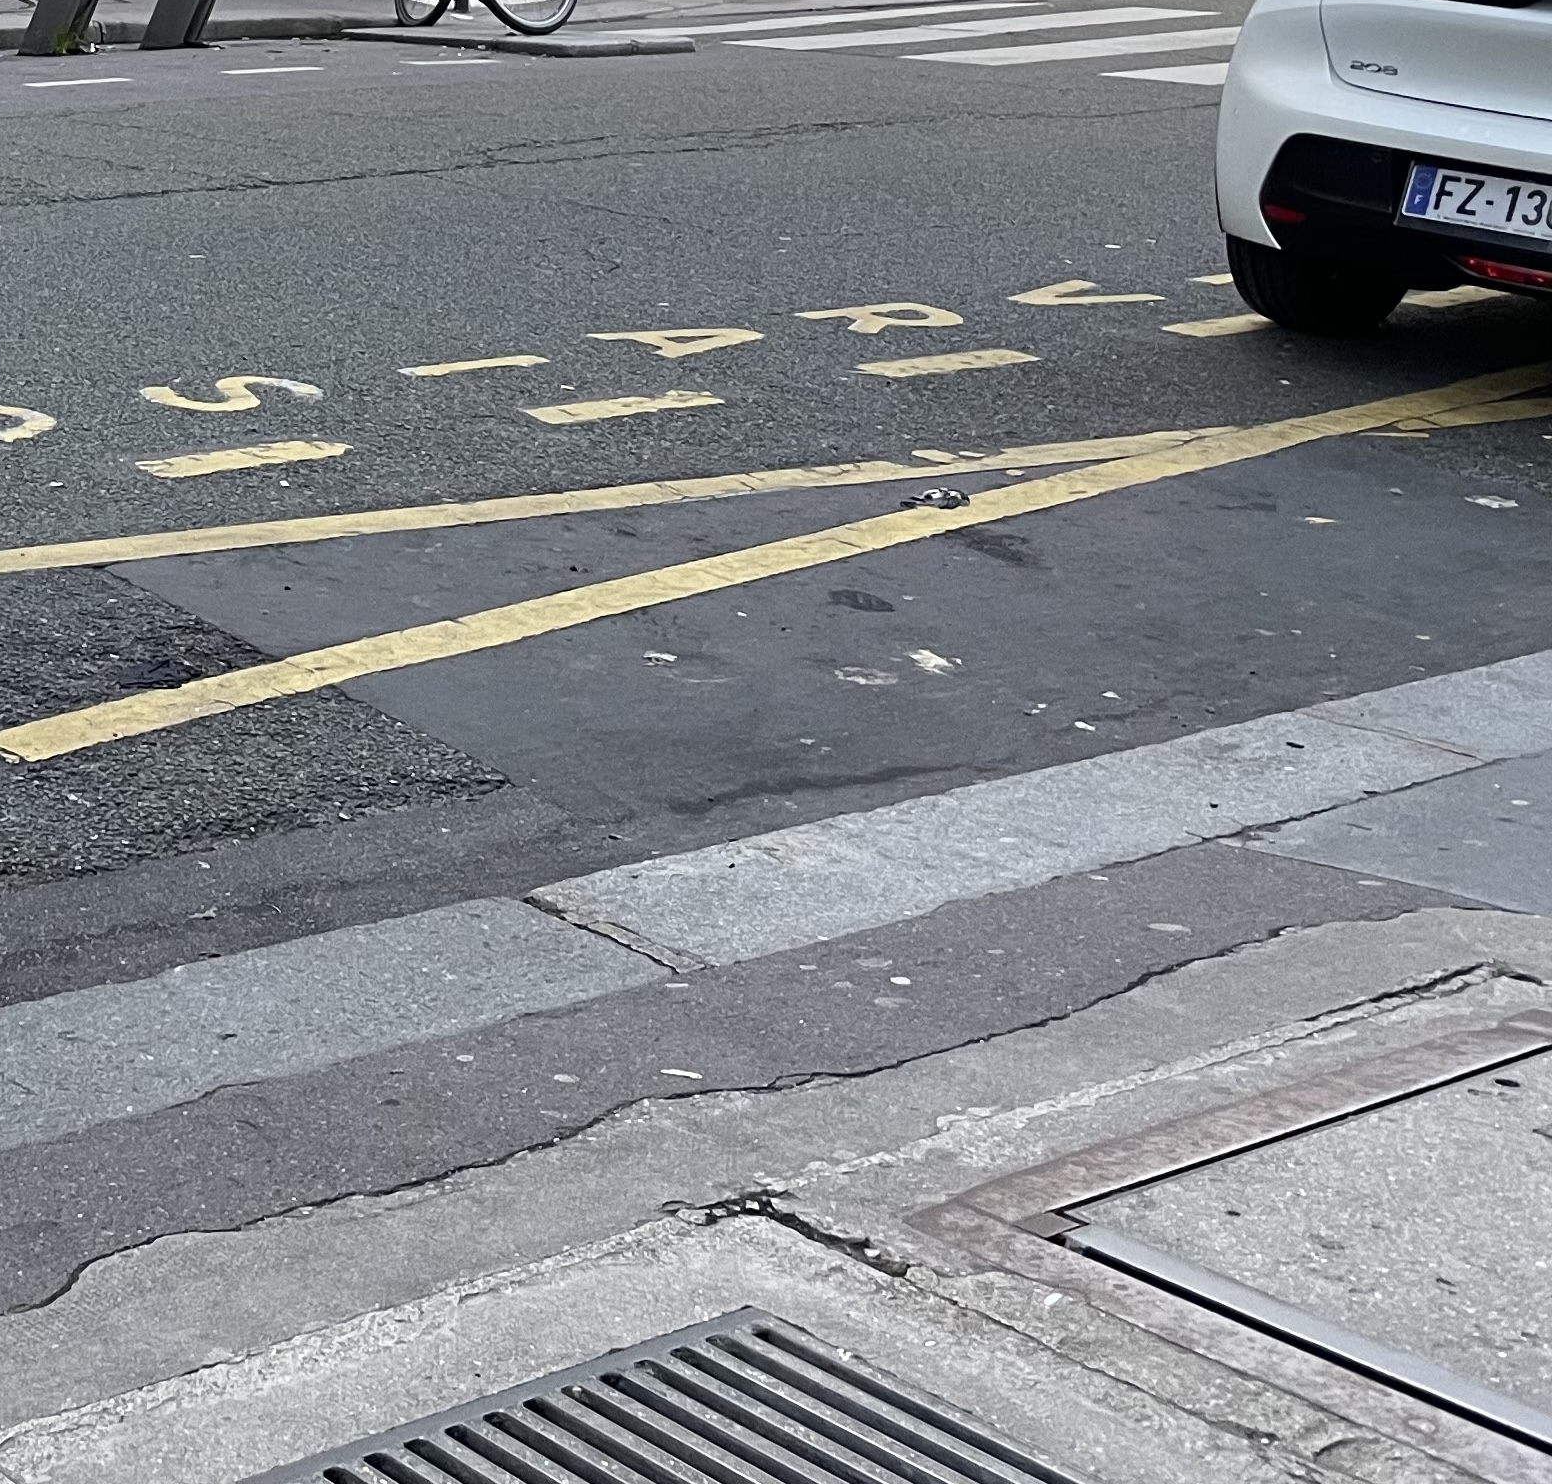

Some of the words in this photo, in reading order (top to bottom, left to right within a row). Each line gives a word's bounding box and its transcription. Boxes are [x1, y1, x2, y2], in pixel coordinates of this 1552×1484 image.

[1349, 60, 1398, 76] 208
[1414, 194, 1424, 205] F
[1433, 174, 1552, 231] FZ-13
